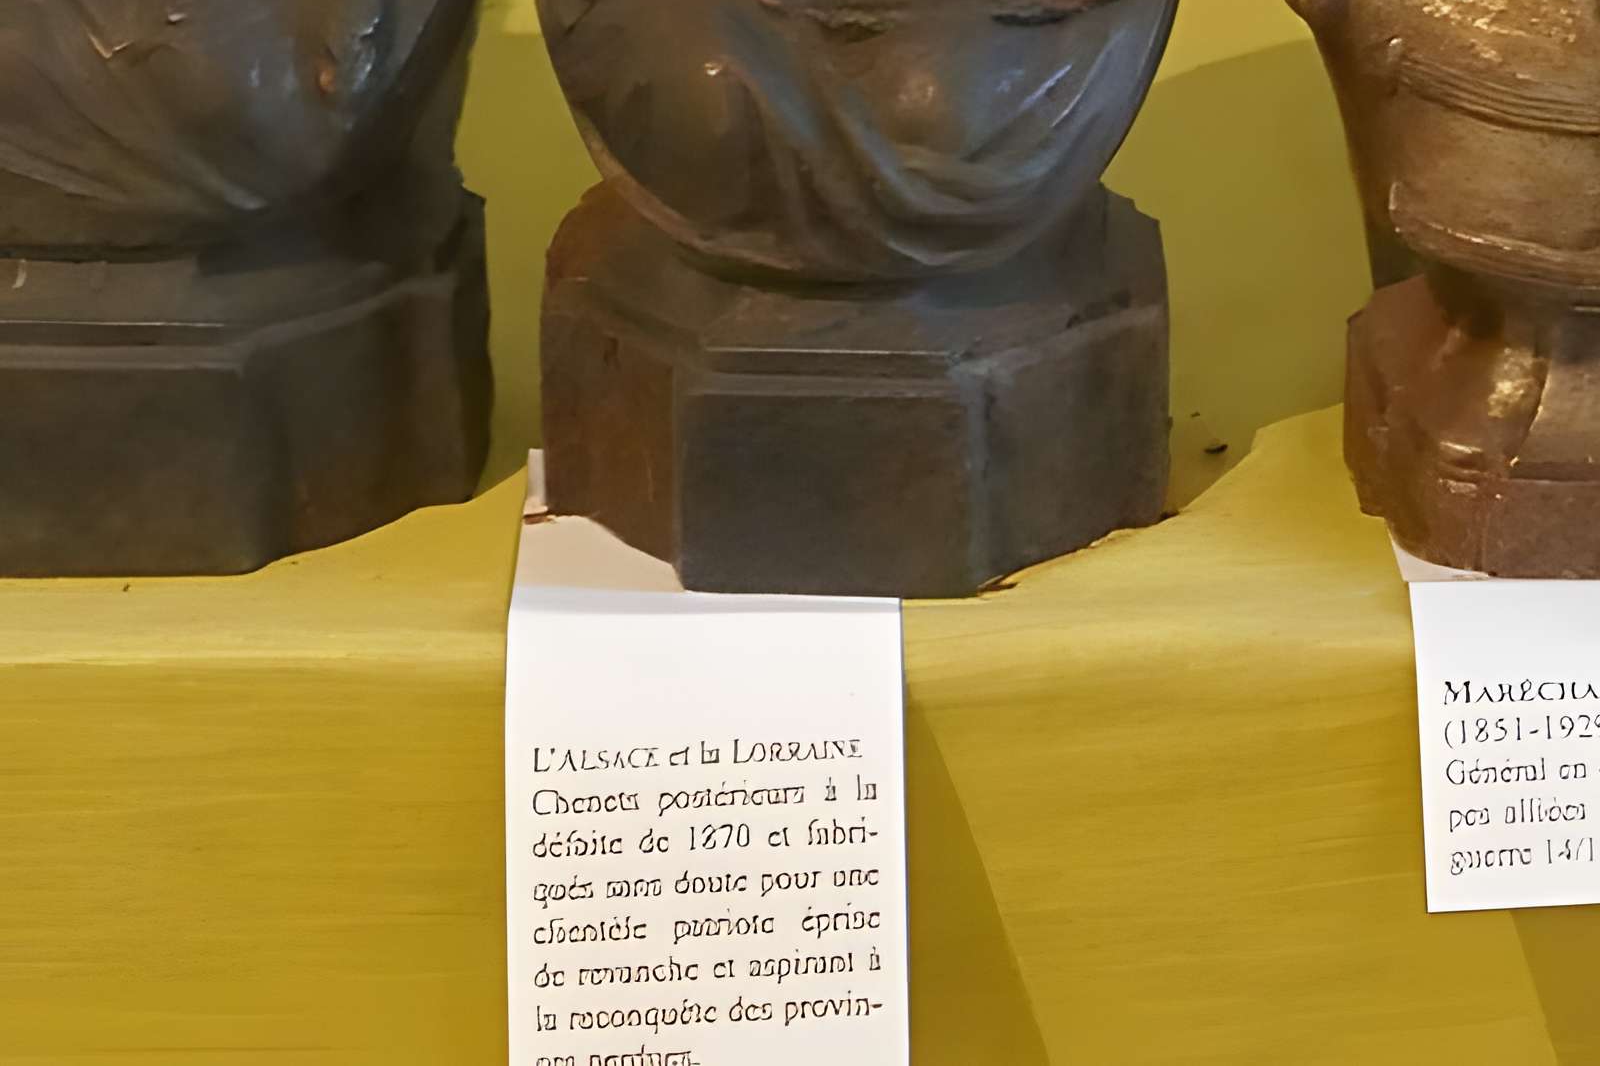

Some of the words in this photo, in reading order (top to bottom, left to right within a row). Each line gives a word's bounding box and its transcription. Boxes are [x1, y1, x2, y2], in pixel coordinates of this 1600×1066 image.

[668, 745, 691, 767] et
[700, 740, 721, 765] la
[732, 738, 863, 765] LORRAINE
[1445, 756, 1546, 786] Général
[1558, 762, 1587, 781] en
[532, 788, 641, 816] Chenets
[657, 779, 806, 818] postérieurs
[823, 775, 838, 802] à
[856, 773, 878, 802] la
[1449, 807, 1491, 834] pes
[1504, 796, 1586, 825] alliées
[531, 829, 624, 859] défaite
[638, 827, 670, 854] de
[688, 822, 751, 852] 1870
[767, 826, 791, 848] et
[1450, 847, 1532, 877] guerre
[673, 869, 748, 895] doute
[760, 870, 823, 898] pour
[832, 868, 880, 888] une
[533, 915, 648, 945] clientèle
[672, 907, 775, 946] patriote
[800, 901, 881, 940] éprise
[533, 962, 566, 989] de
[577, 955, 700, 987] revanche
[712, 958, 736, 980] et
[747, 948, 854, 985] aspirant
[868, 944, 882, 972] à
[536, 1004, 558, 1033] la
[569, 998, 718, 1036] reconquête
[728, 994, 773, 1023] des
